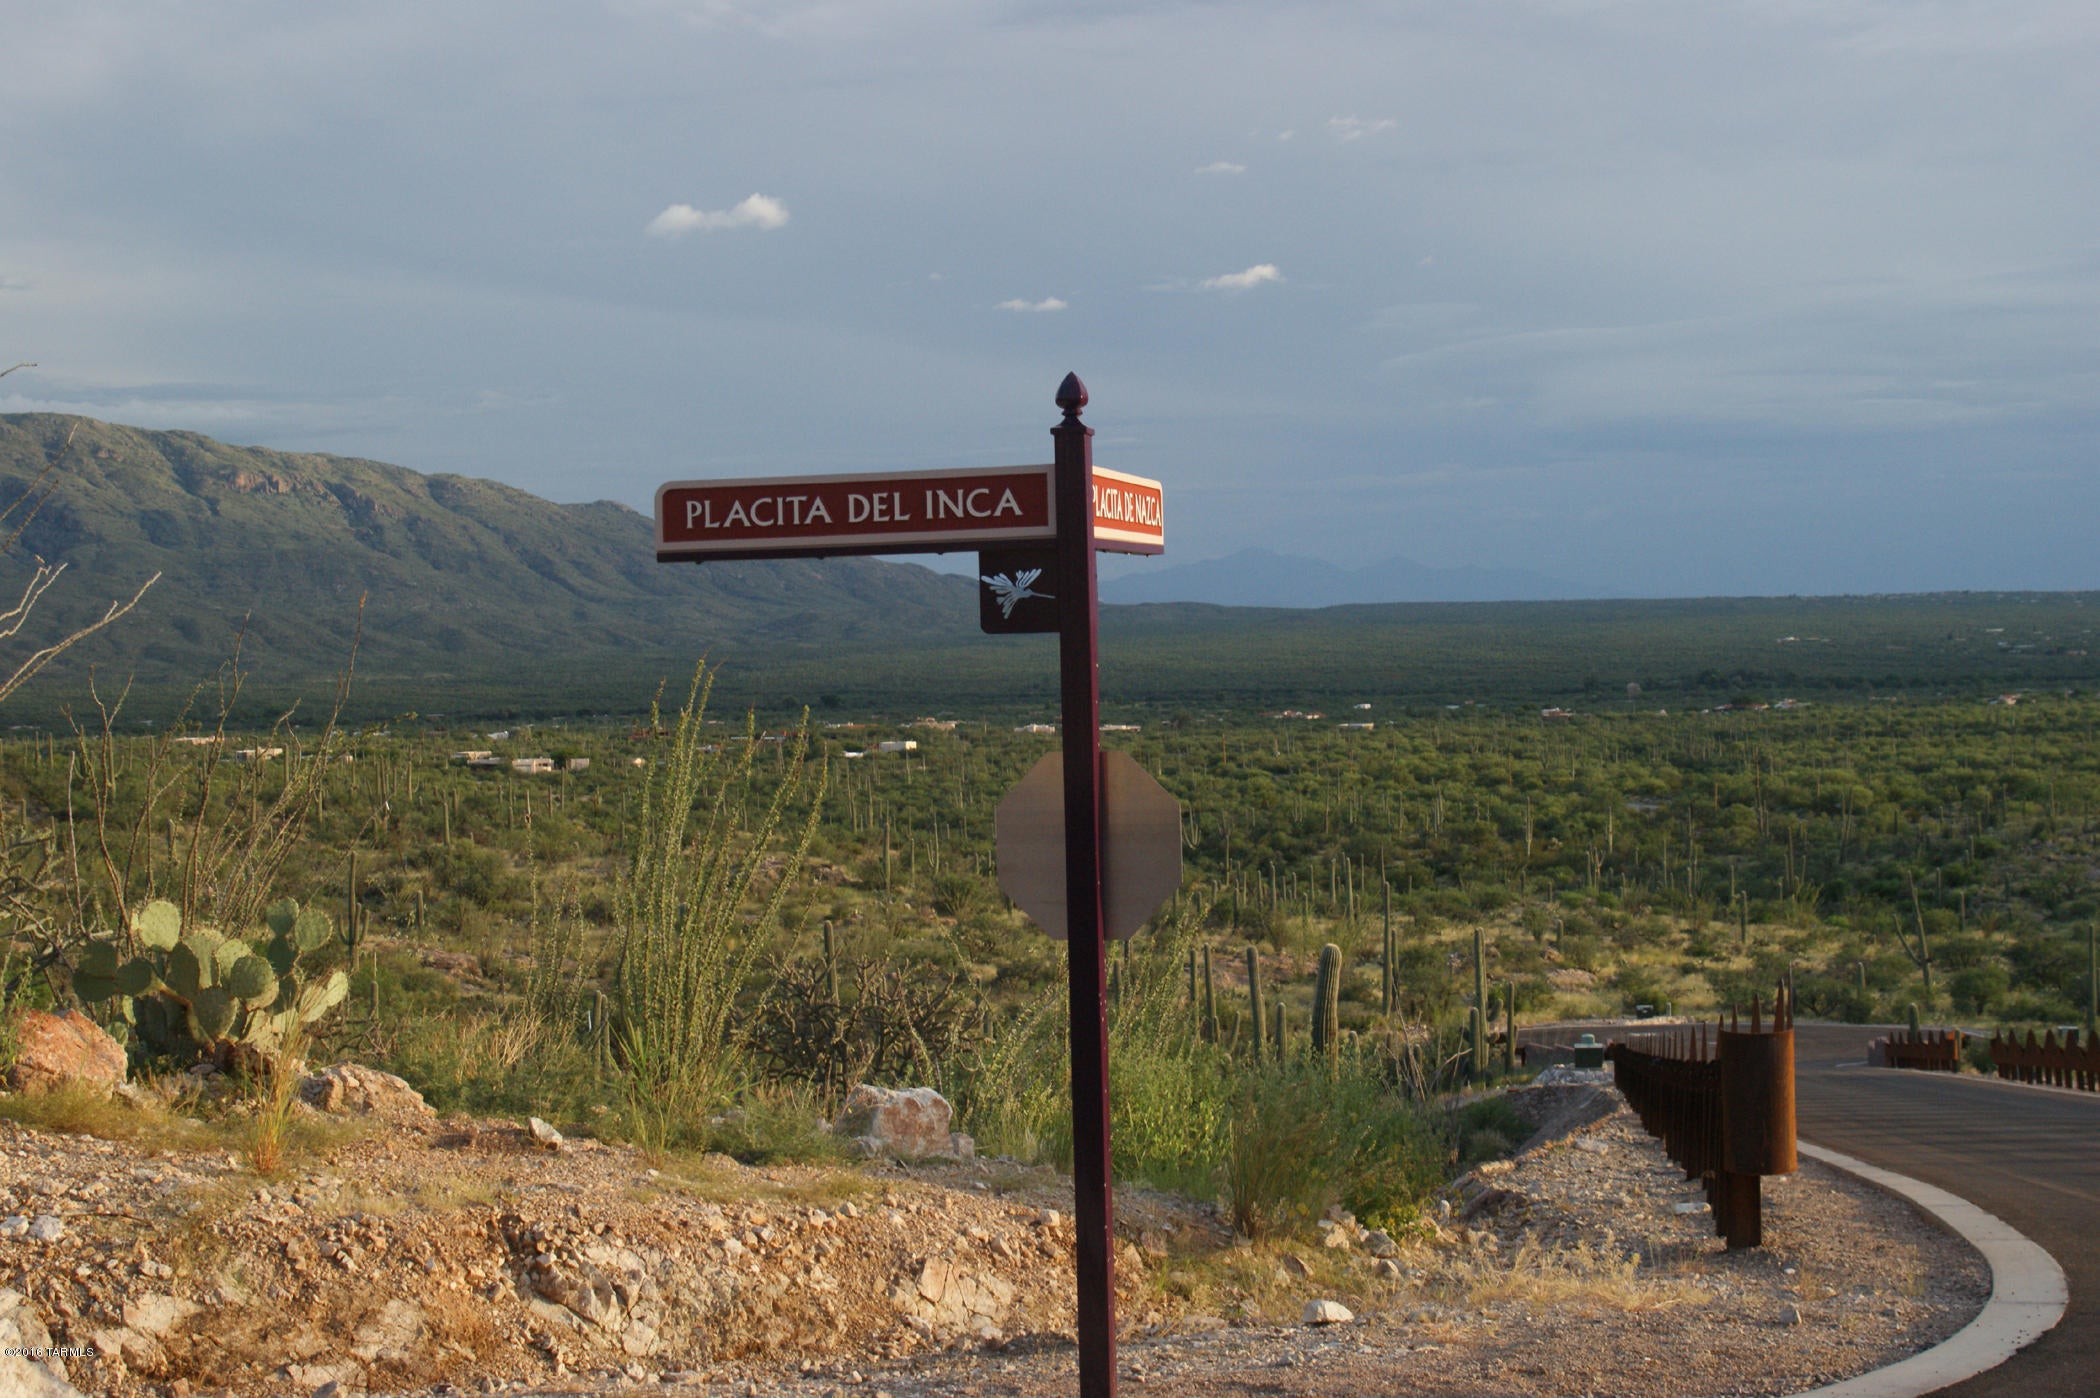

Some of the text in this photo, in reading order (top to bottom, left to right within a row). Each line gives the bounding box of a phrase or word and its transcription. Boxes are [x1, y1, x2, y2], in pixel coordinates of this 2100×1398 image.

[685, 488, 1024, 529] PLACITA DEL INCA
[1124, 491, 1135, 523] DE
[1135, 493, 1162, 527] NAZCA
